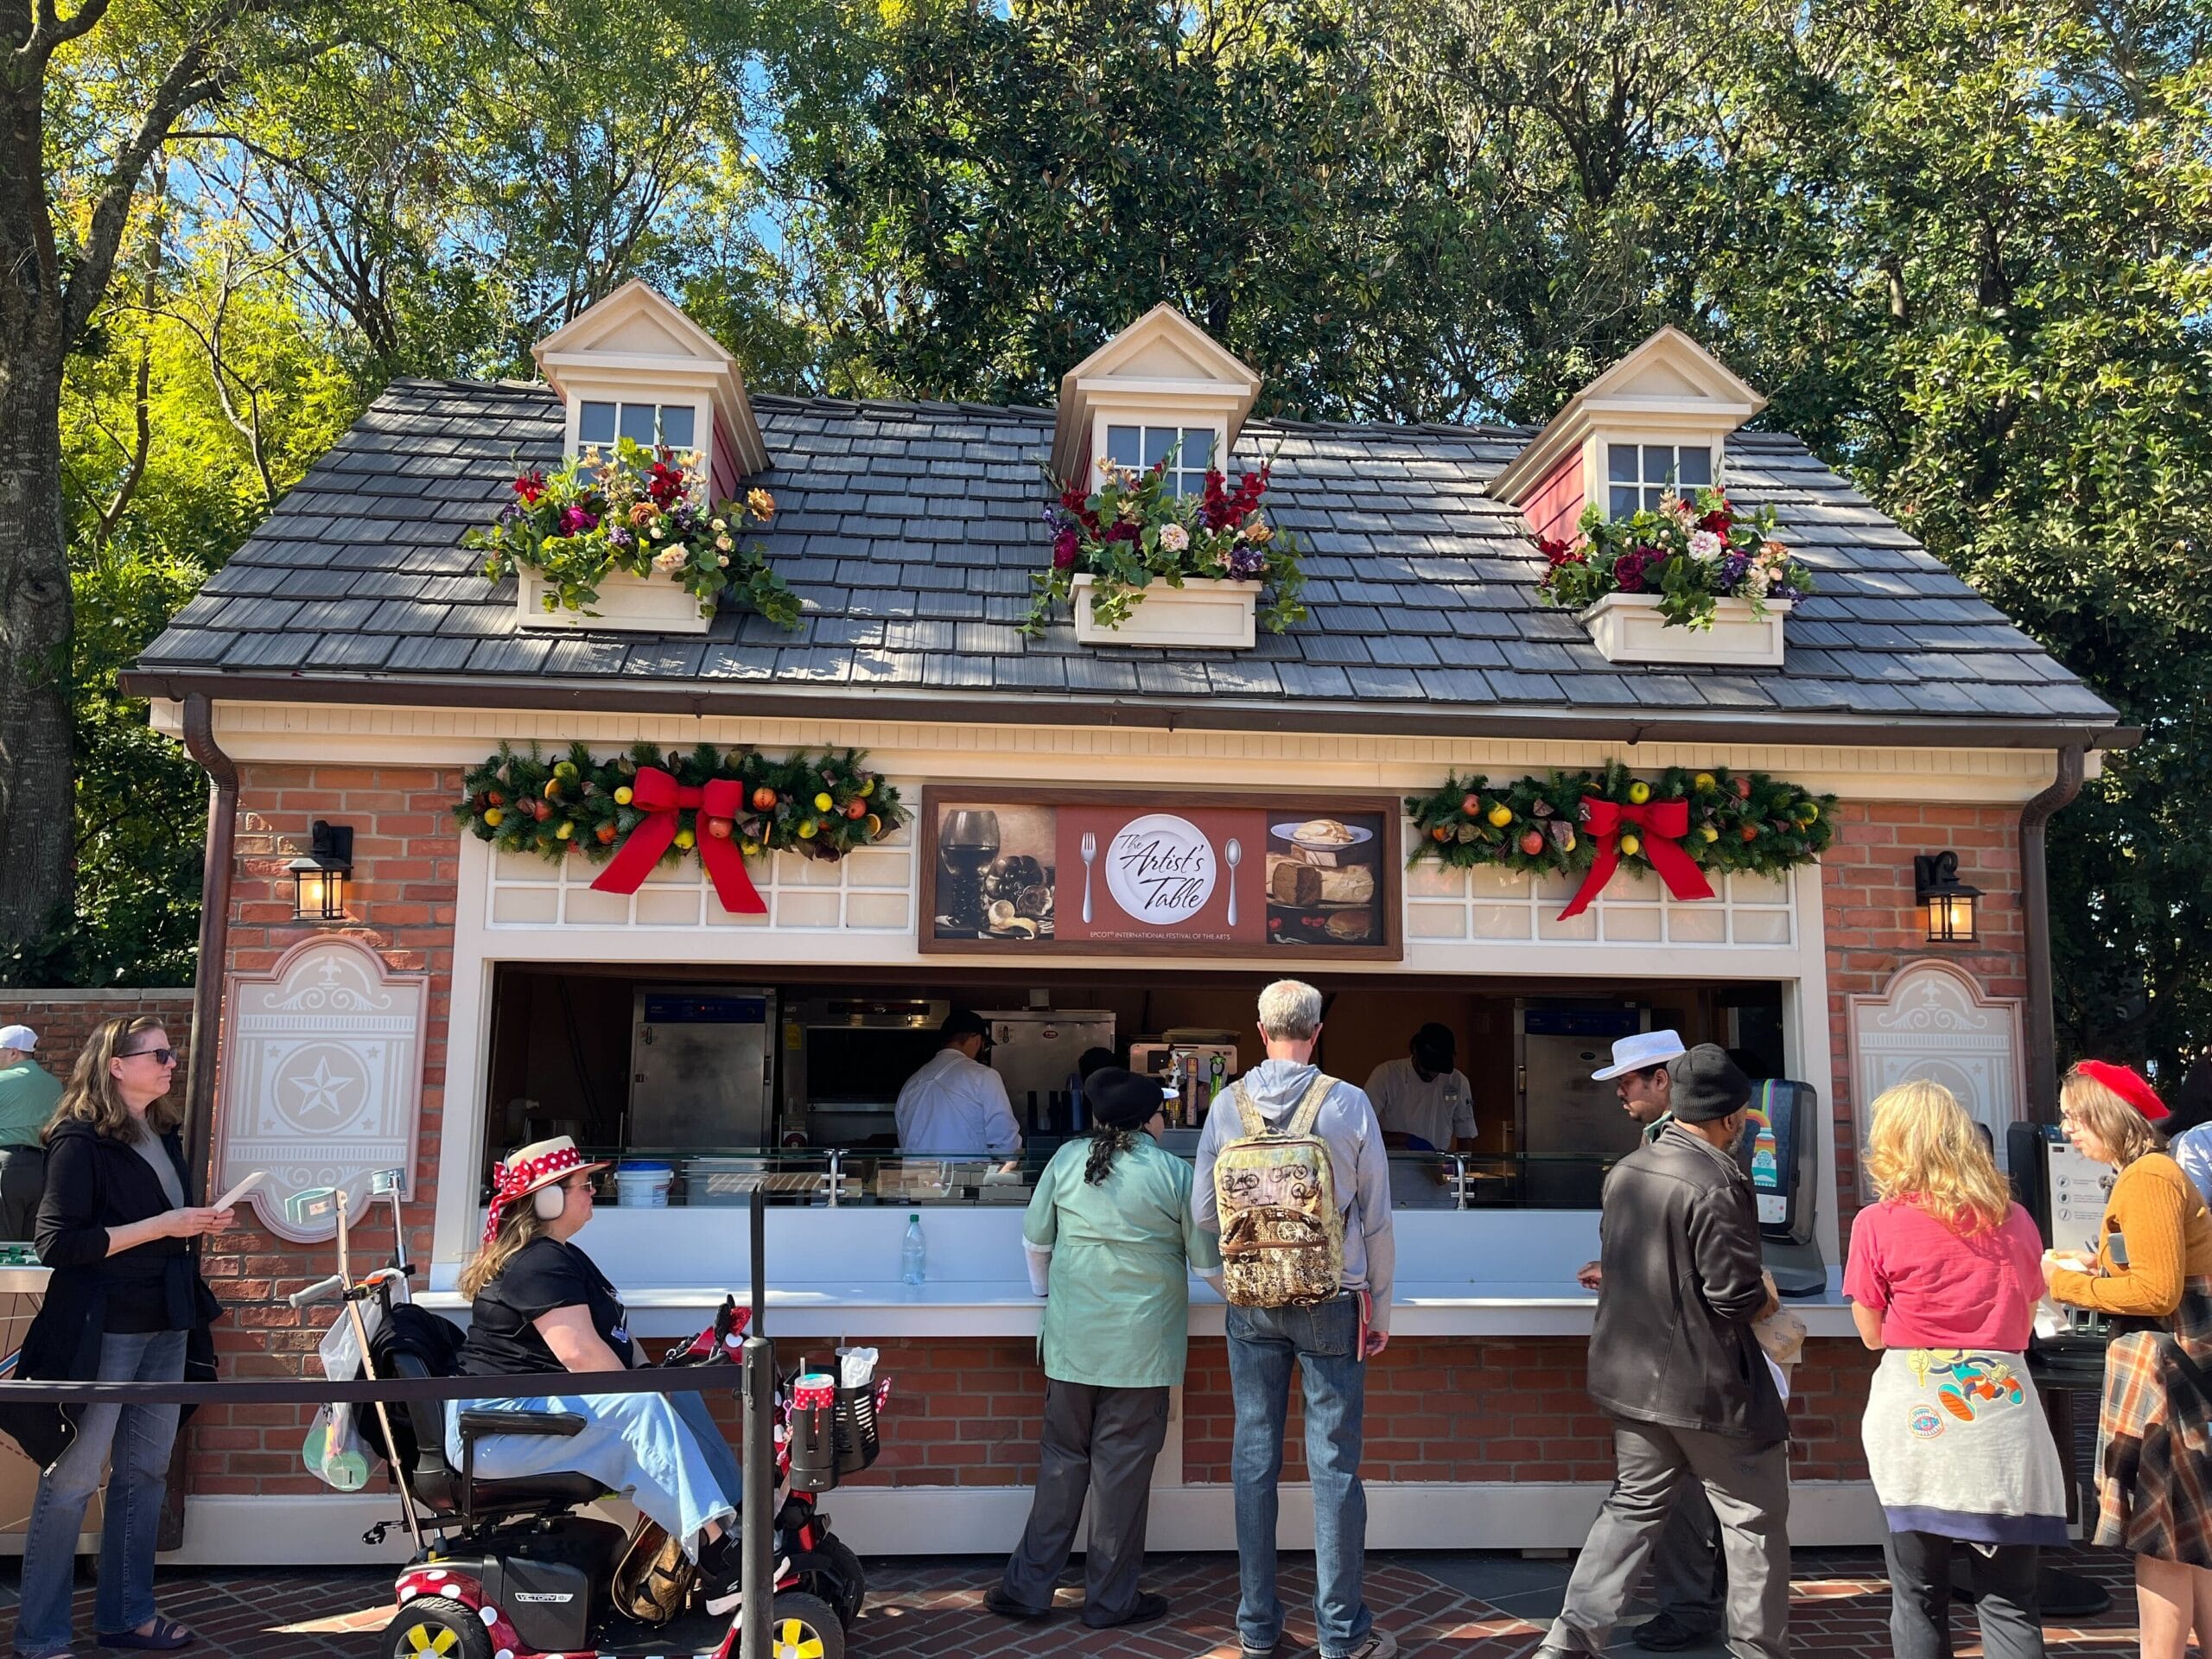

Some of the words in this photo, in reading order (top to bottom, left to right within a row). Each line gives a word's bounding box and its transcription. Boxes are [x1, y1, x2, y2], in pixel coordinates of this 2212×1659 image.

[1119, 834, 1143, 850] The
[1120, 840, 1205, 876] Artist's
[1139, 876, 1205, 910] Table
